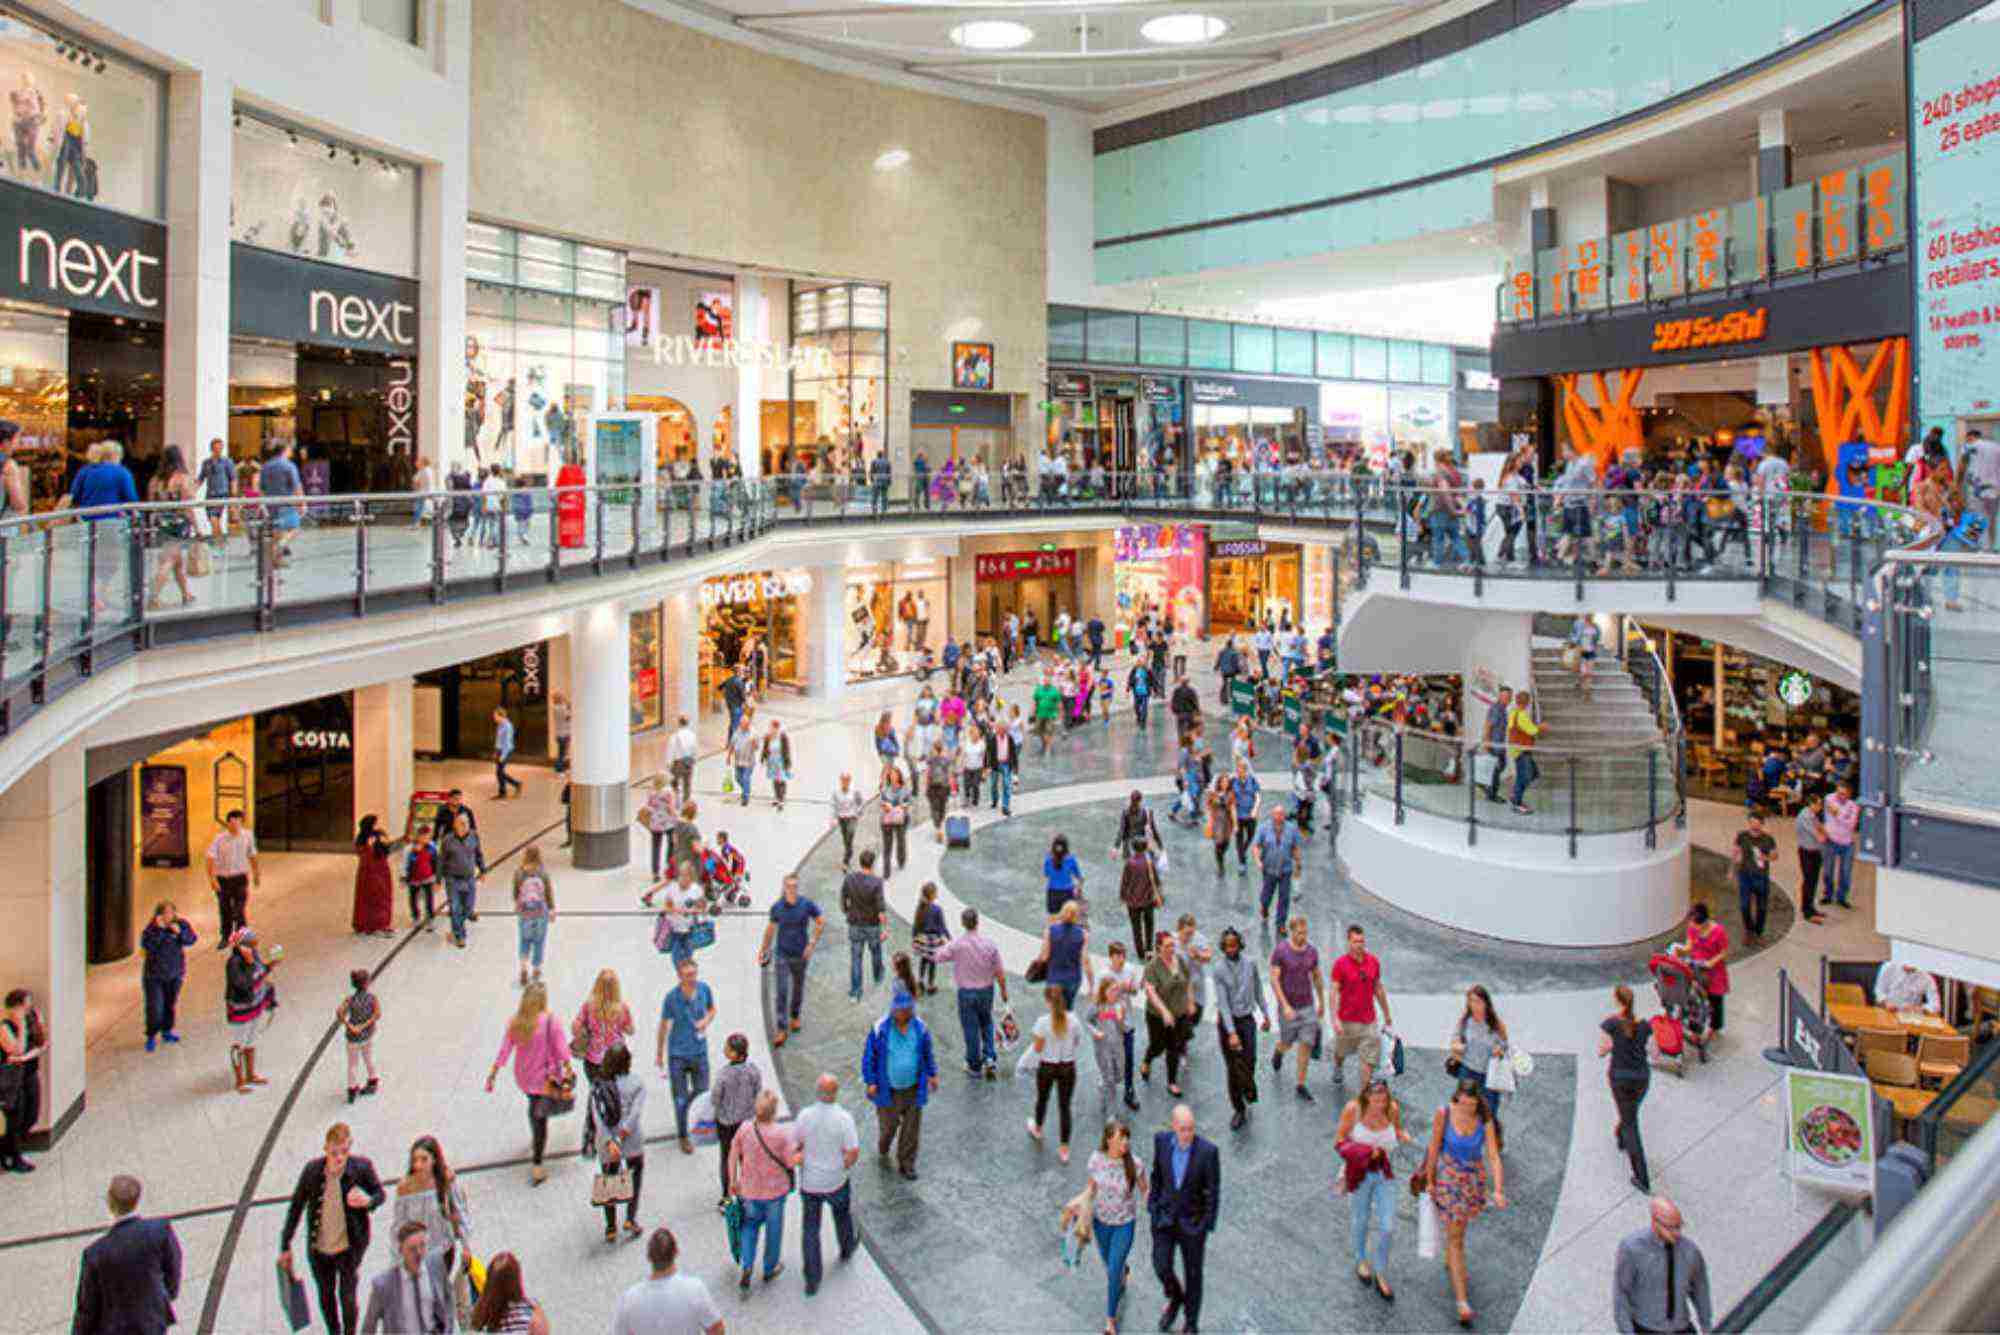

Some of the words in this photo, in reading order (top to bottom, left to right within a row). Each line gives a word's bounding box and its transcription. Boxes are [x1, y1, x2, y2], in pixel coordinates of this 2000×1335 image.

[1923, 92, 1953, 126] 240
[1940, 122, 1960, 151] 25
[1928, 234, 1947, 261] 60
[19, 224, 159, 307] next
[309, 289, 414, 345] next
[653, 335, 739, 369] RIVER
[387, 360, 413, 456] next
[701, 577, 756, 604] RIVER
[292, 731, 350, 749] COSTA
